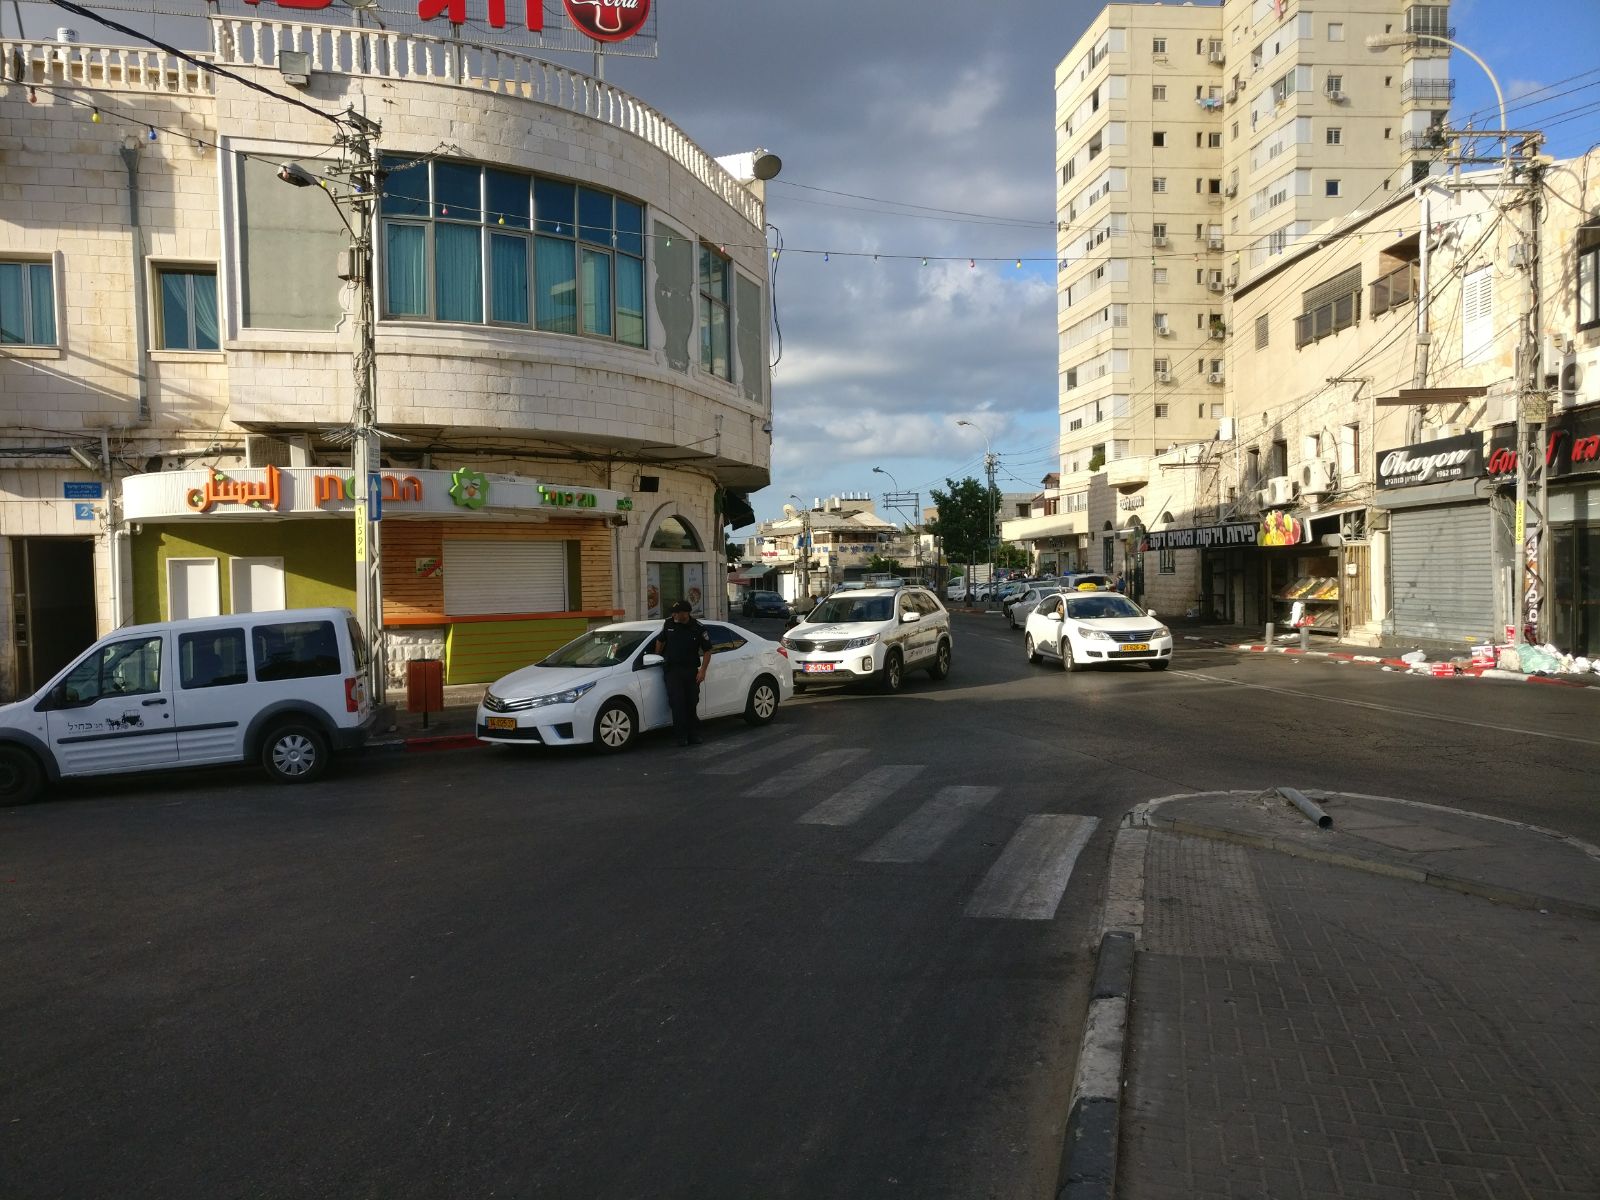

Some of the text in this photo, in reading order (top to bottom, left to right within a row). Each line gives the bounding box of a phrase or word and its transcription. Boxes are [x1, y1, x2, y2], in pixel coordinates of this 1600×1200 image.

[1380, 449, 1471, 481] Ohayon
[80, 506, 89, 517] 2
[1149, 524, 1256, 550] פירות וירקות האחים דקה
[67, 722, 93, 731] כחיל
